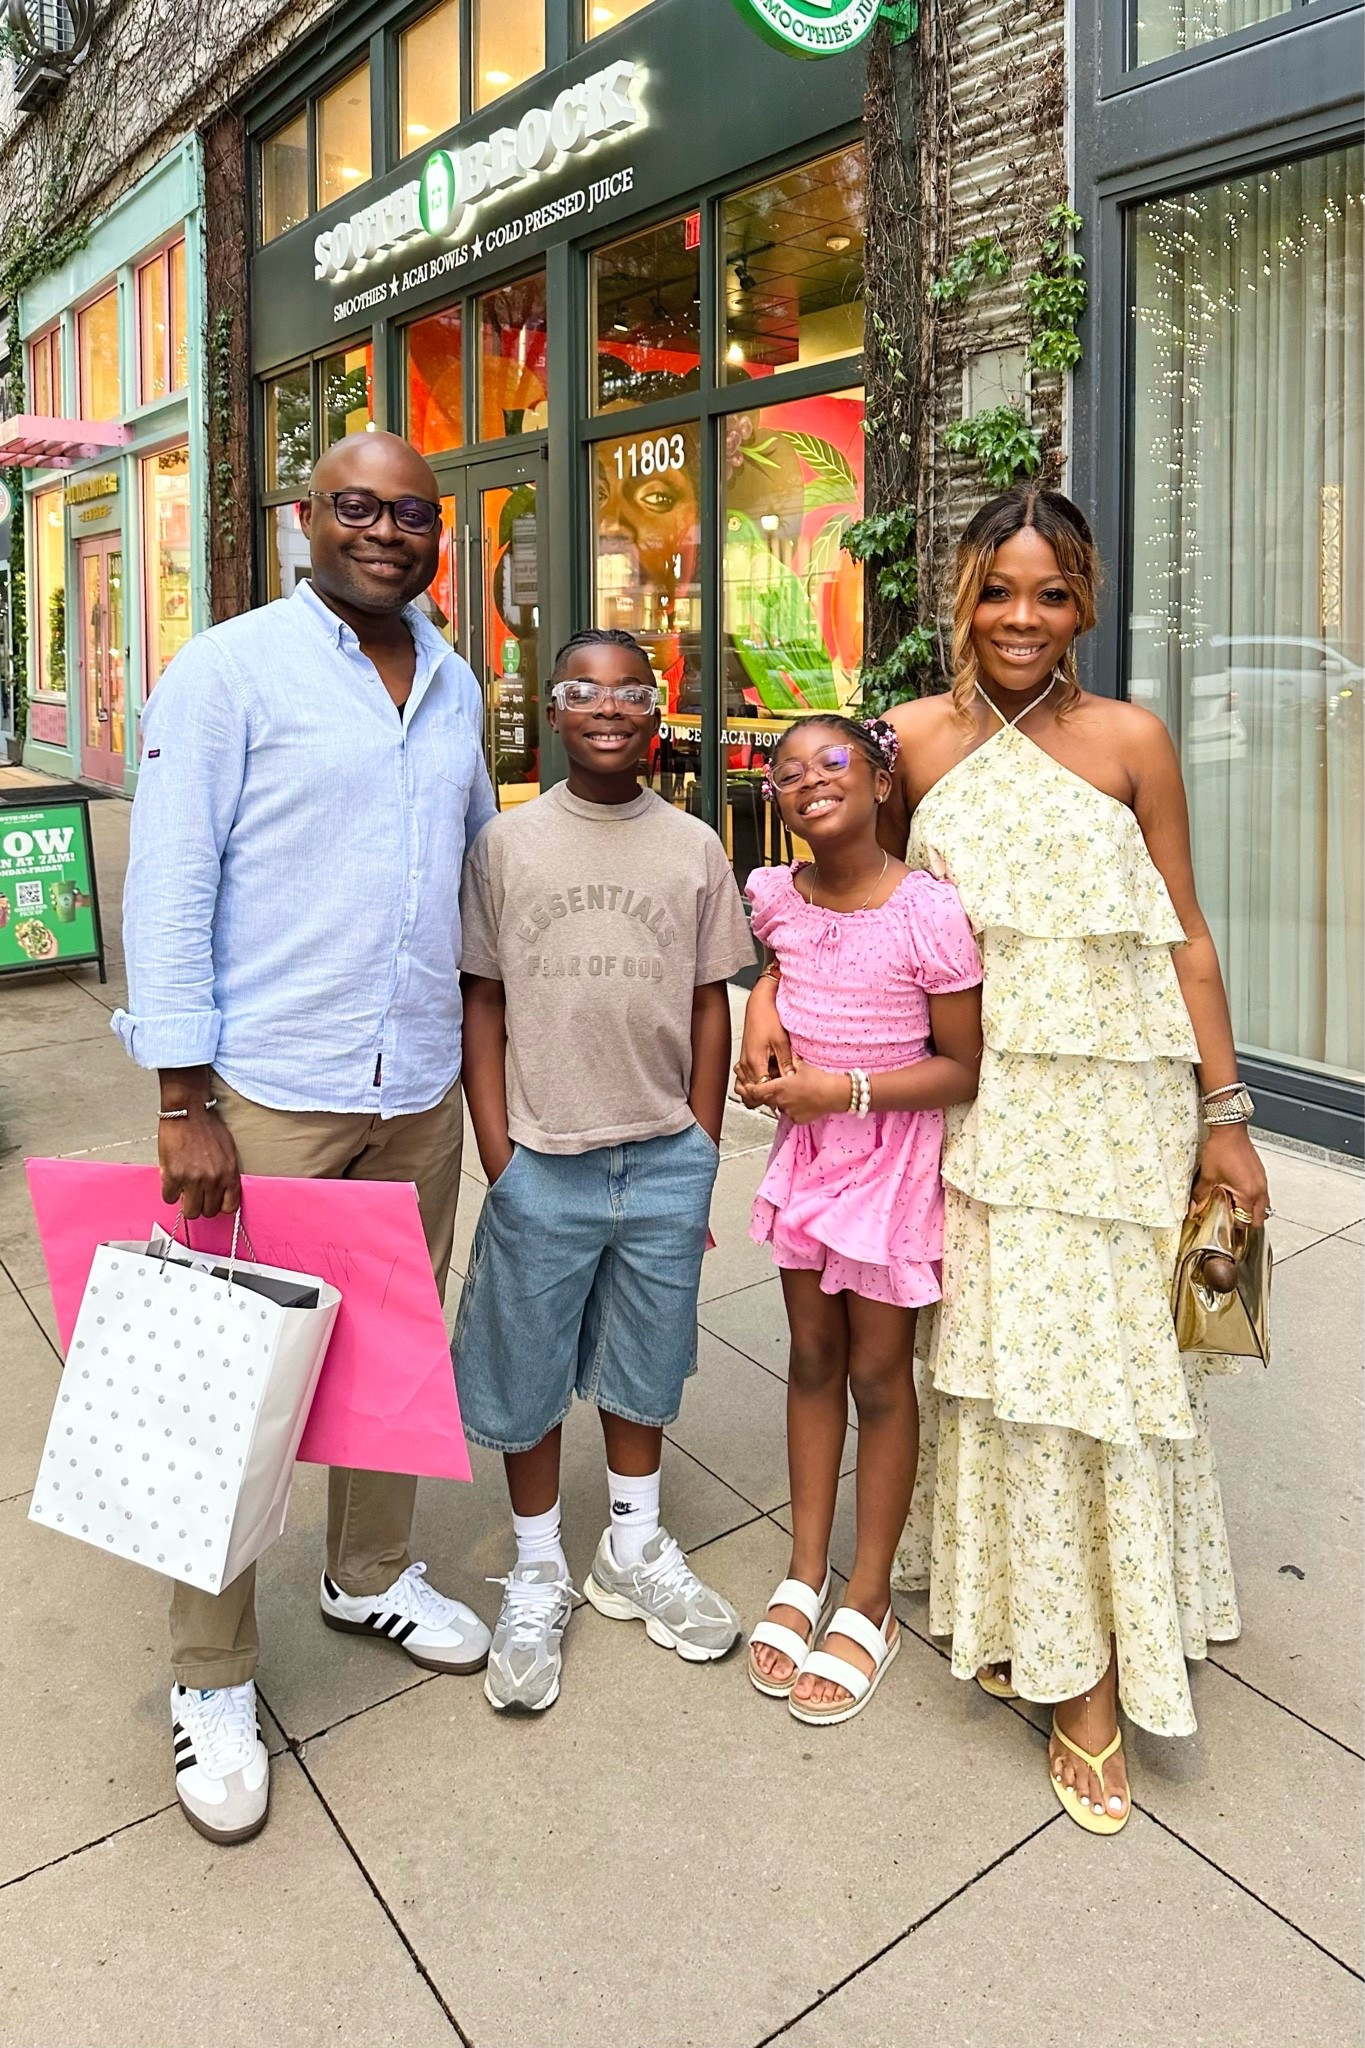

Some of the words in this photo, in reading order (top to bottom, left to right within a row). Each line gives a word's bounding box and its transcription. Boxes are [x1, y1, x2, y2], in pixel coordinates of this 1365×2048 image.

[760, 0, 853, 44] MOOTHIES
[856, 0, 876, 23] JU
[314, 179, 424, 281] SOUTH
[459, 59, 637, 206] BLOCK
[333, 282, 388, 323] SMOOTHIES
[401, 262, 429, 292] ACAI
[429, 244, 469, 279] BOWLS
[485, 218, 524, 252] COLD
[524, 189, 586, 237] PRESSED
[587, 166, 635, 213] JUICE
[613, 433, 685, 480] 11803
[719, 729, 752, 746] ACAI
[754, 731, 784, 748] BOW
[3, 826, 75, 858] OW
[16, 856, 35, 868] AT
[38, 852, 76, 865] 7AM!
[515, 884, 676, 948] ESSENTIALS
[527, 955, 582, 977] FEAR
[588, 955, 617, 977] OF
[623, 956, 663, 979] GOD
